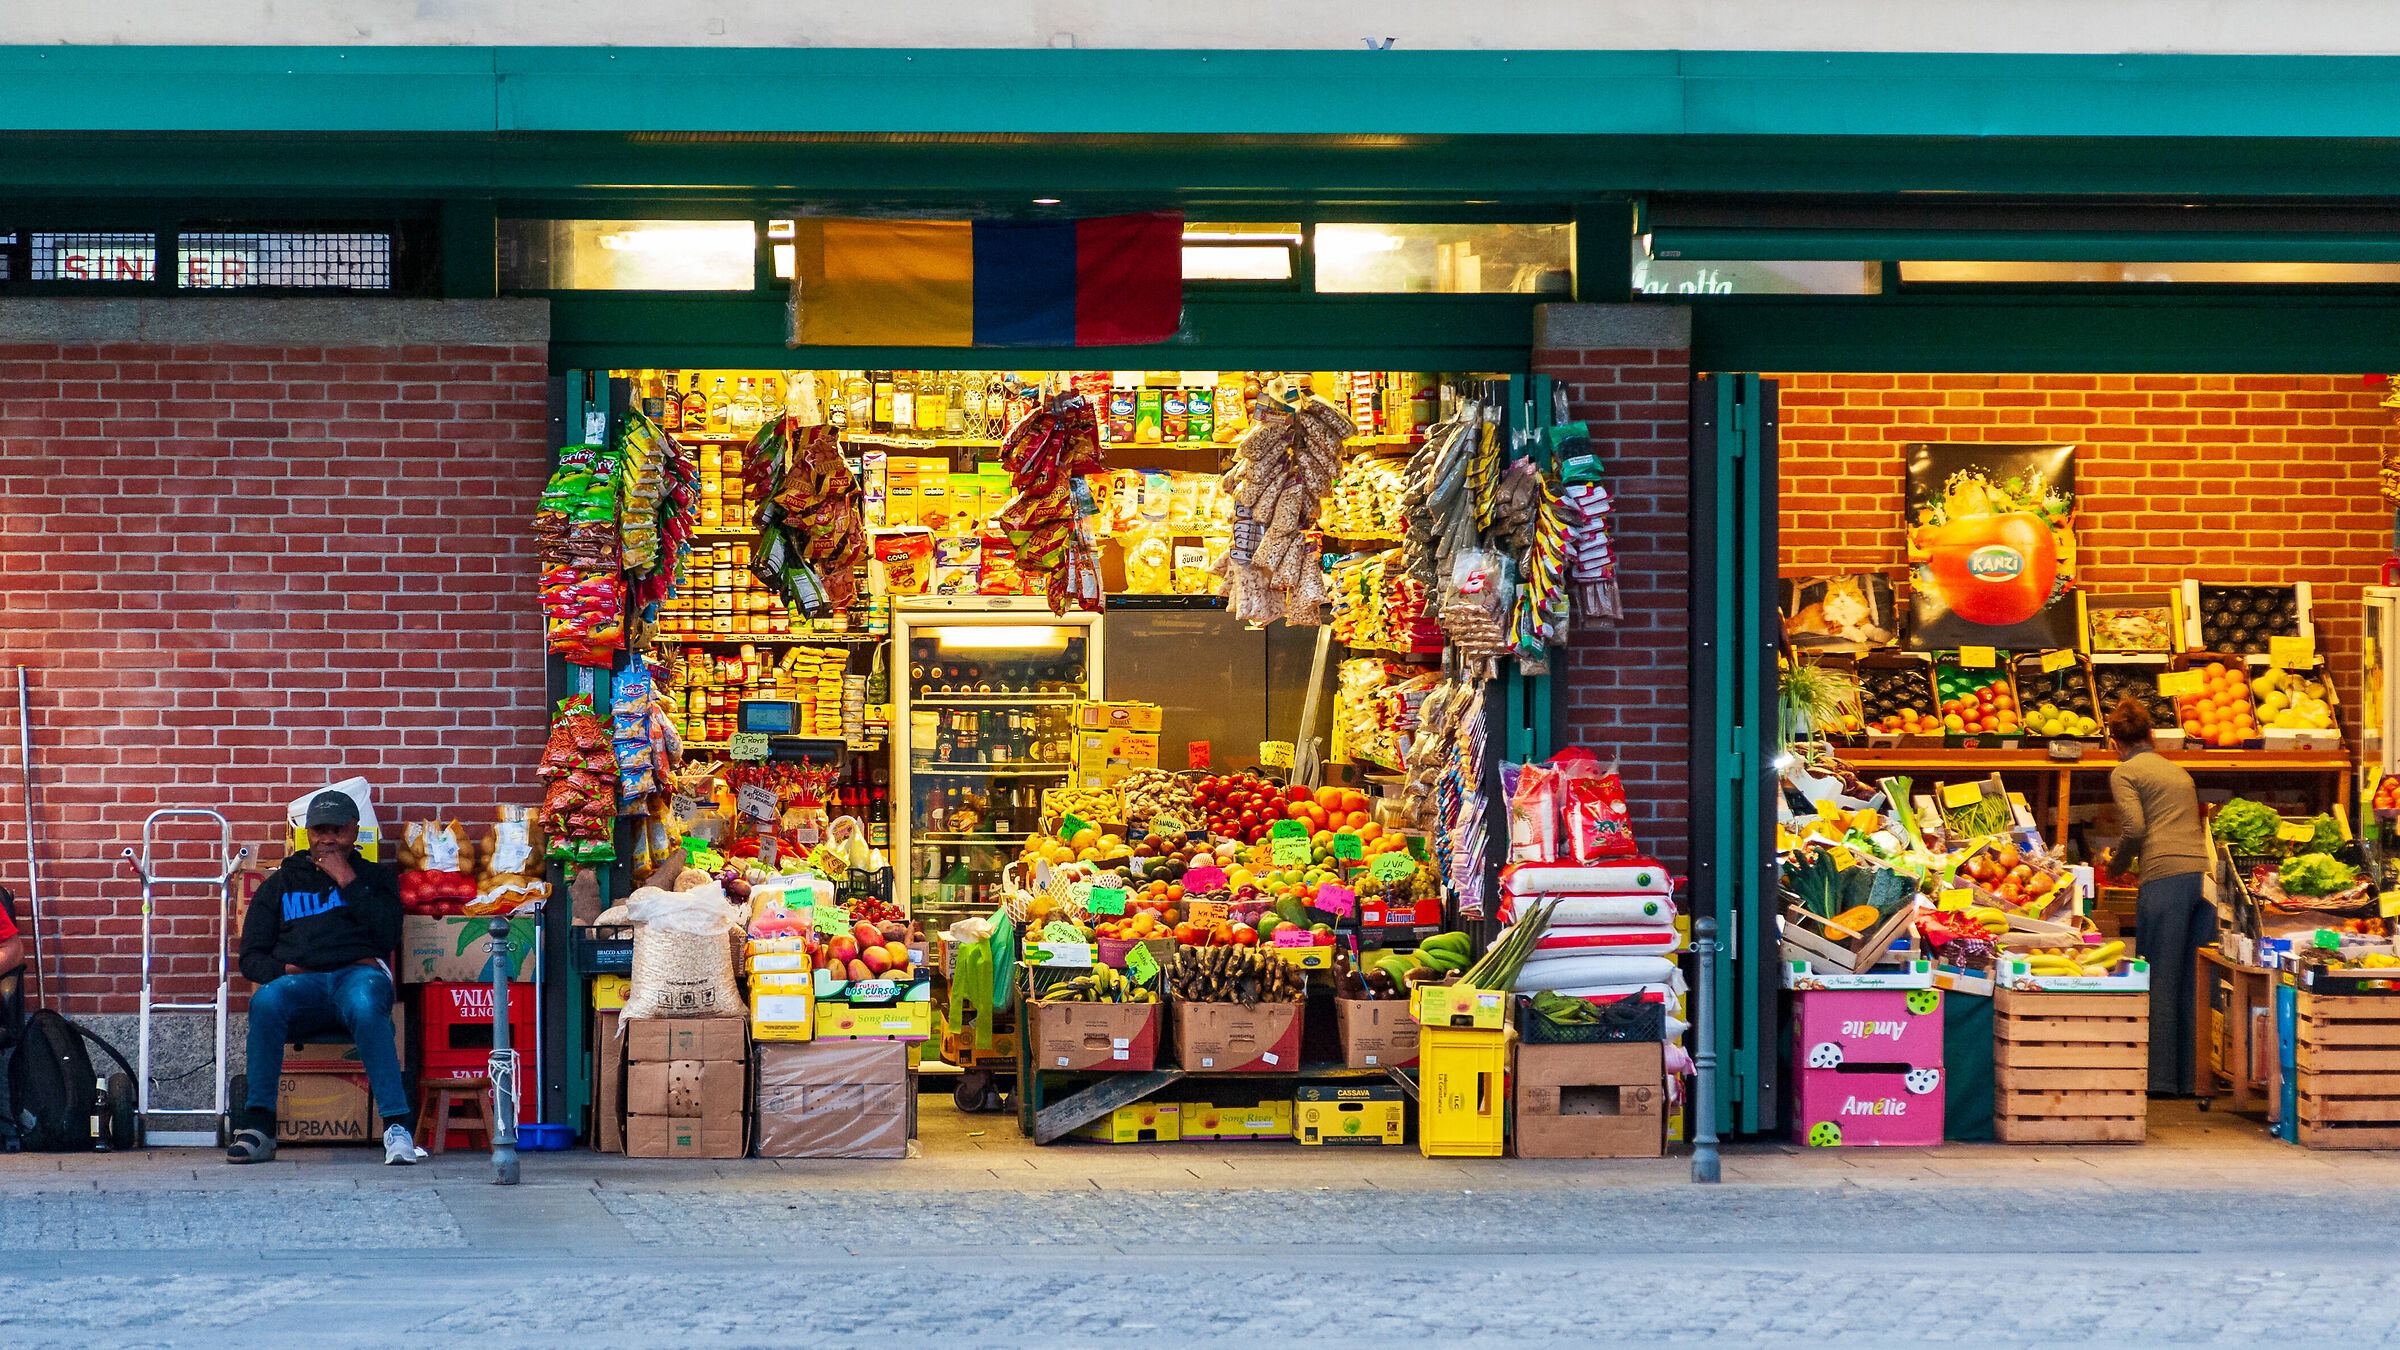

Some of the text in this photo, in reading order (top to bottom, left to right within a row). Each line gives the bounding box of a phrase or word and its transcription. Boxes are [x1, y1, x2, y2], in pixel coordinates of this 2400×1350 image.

[1139, 392, 1160, 401] BEST
[886, 553, 909, 562] GOYA
[1182, 555, 1203, 564] QUEIJO
[1972, 556, 2018, 572] KANZI
[1383, 860, 1404, 868] UVA
[282, 886, 347, 922] MILA
[815, 907, 840, 920] MANGO
[845, 987, 901, 996] LOS CURSOS
[460, 1007, 494, 1017] ONTE
[857, 1014, 910, 1024] Song River
[1841, 1020, 1908, 1041] Amélie
[1337, 1089, 1371, 1097] CASSAVA
[1841, 1095, 1907, 1116] Amélie
[1221, 1113, 1273, 1124] Song River
[276, 1120, 362, 1136] TURBANA
